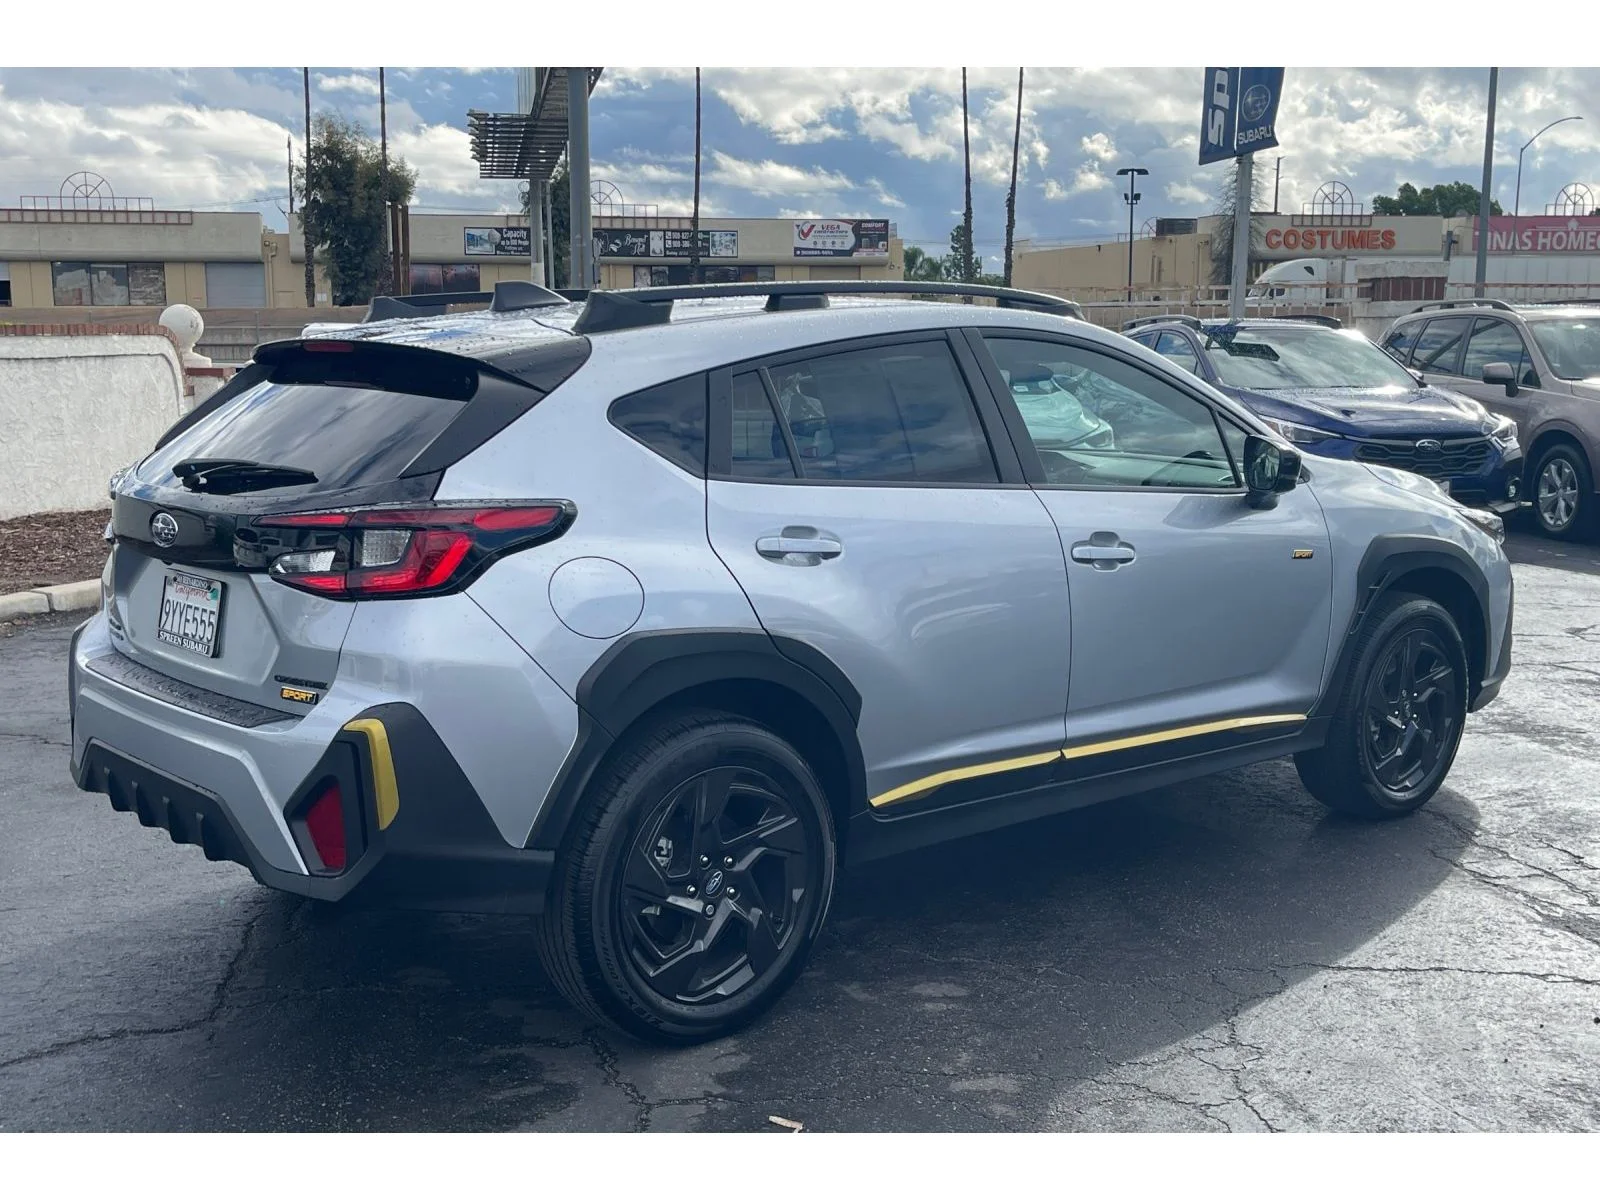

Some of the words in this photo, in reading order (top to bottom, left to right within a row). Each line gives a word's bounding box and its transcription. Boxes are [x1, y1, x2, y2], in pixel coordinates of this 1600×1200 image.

[1207, 67, 1230, 147] SP
[1238, 125, 1272, 144] SUBARU
[502, 228, 527, 240] Capacity
[1265, 228, 1396, 249] COSTUMES
[1474, 231, 1532, 250] INAS
[1537, 231, 1600, 250] HOME
[161, 598, 216, 643] 9YYE555
[159, 631, 182, 646] SPREEN
[182, 638, 209, 654] SUBARU
[282, 689, 314, 703] SPORT
